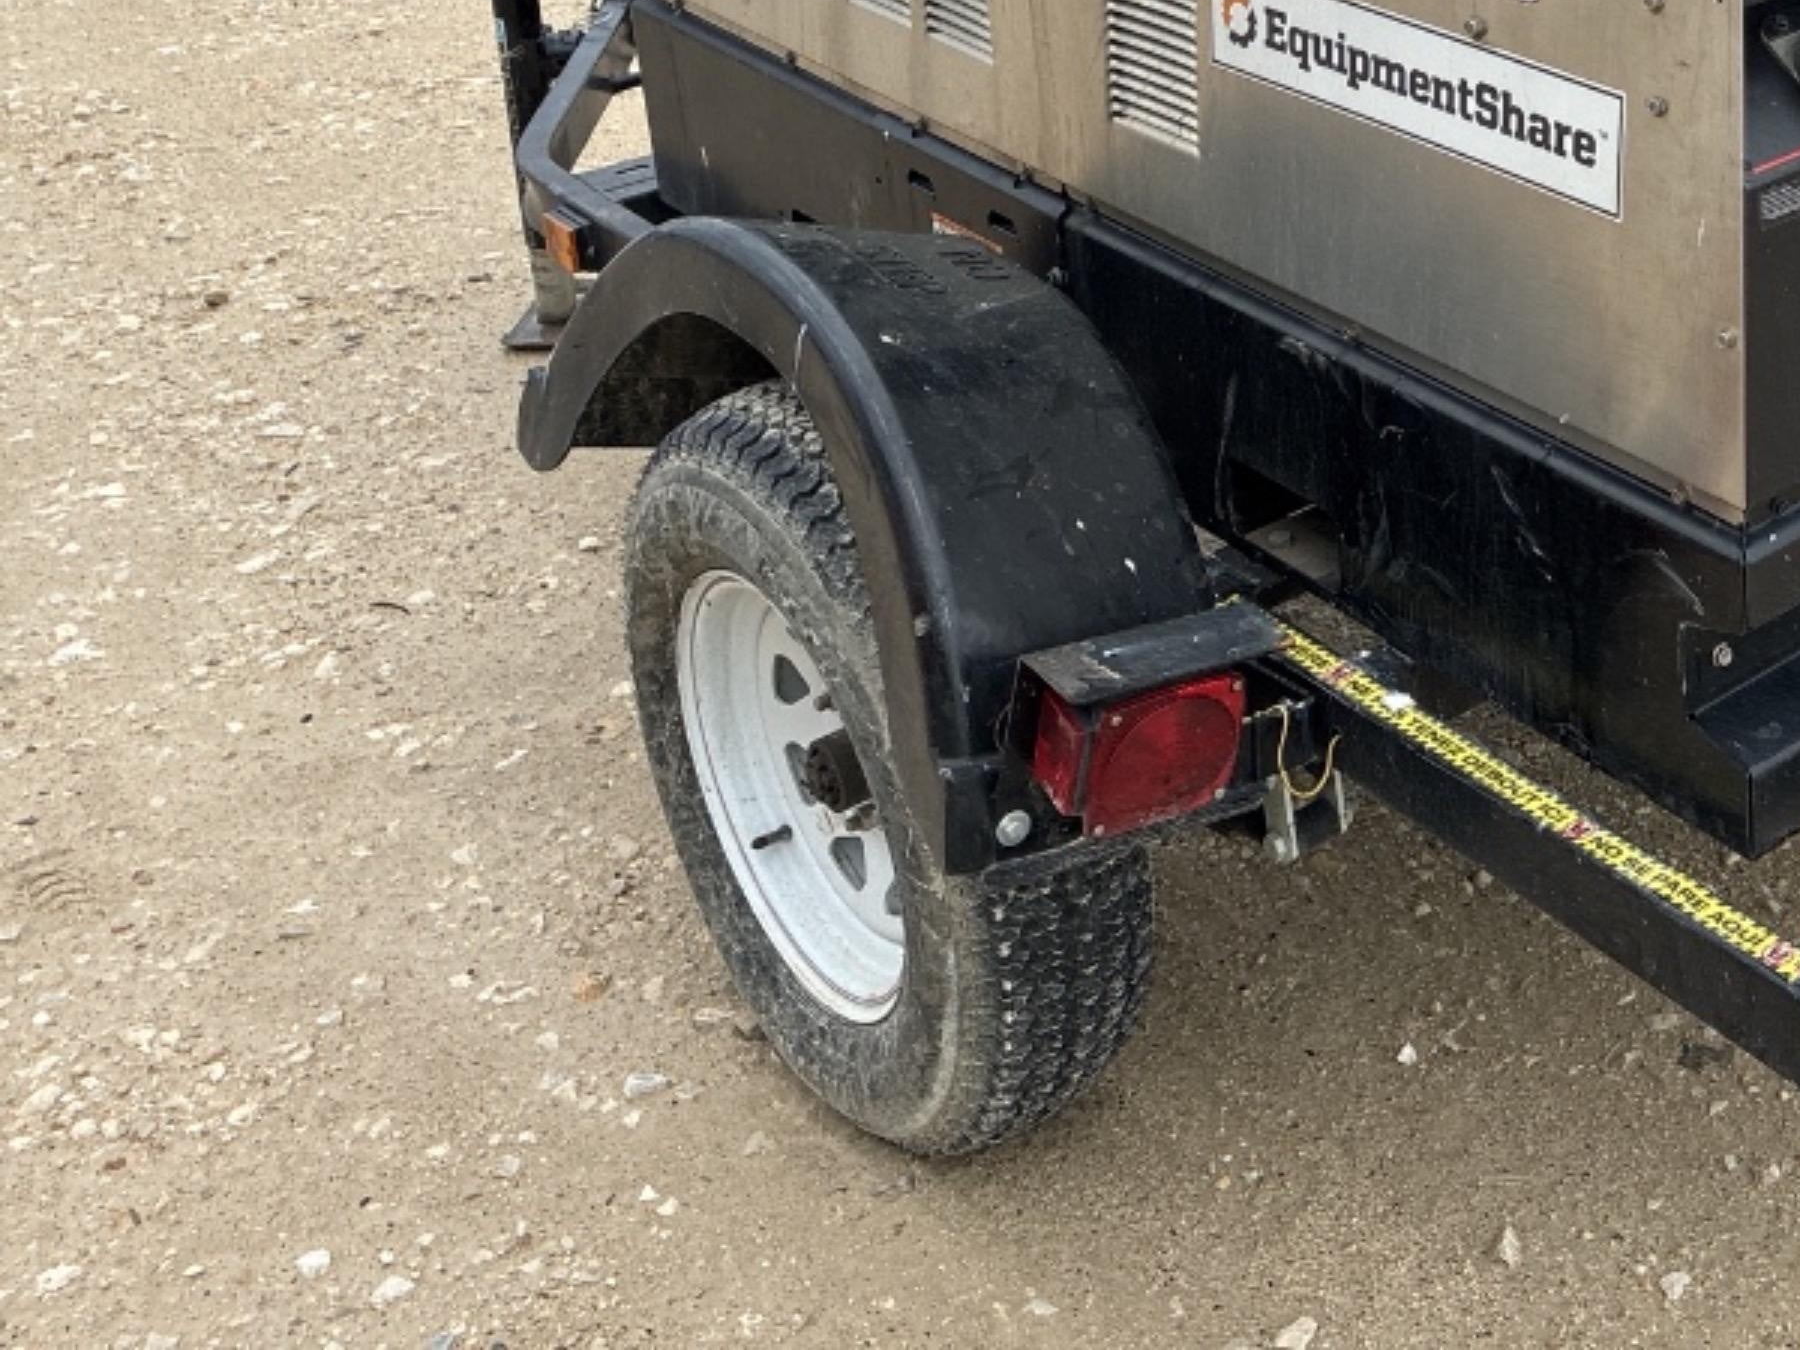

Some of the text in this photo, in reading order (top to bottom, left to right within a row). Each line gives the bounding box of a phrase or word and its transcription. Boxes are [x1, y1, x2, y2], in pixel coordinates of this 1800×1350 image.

[1264, 7, 1598, 169] EquipmentShare
[1589, 835, 1625, 861] NO
[1649, 871, 1713, 912] PARE
